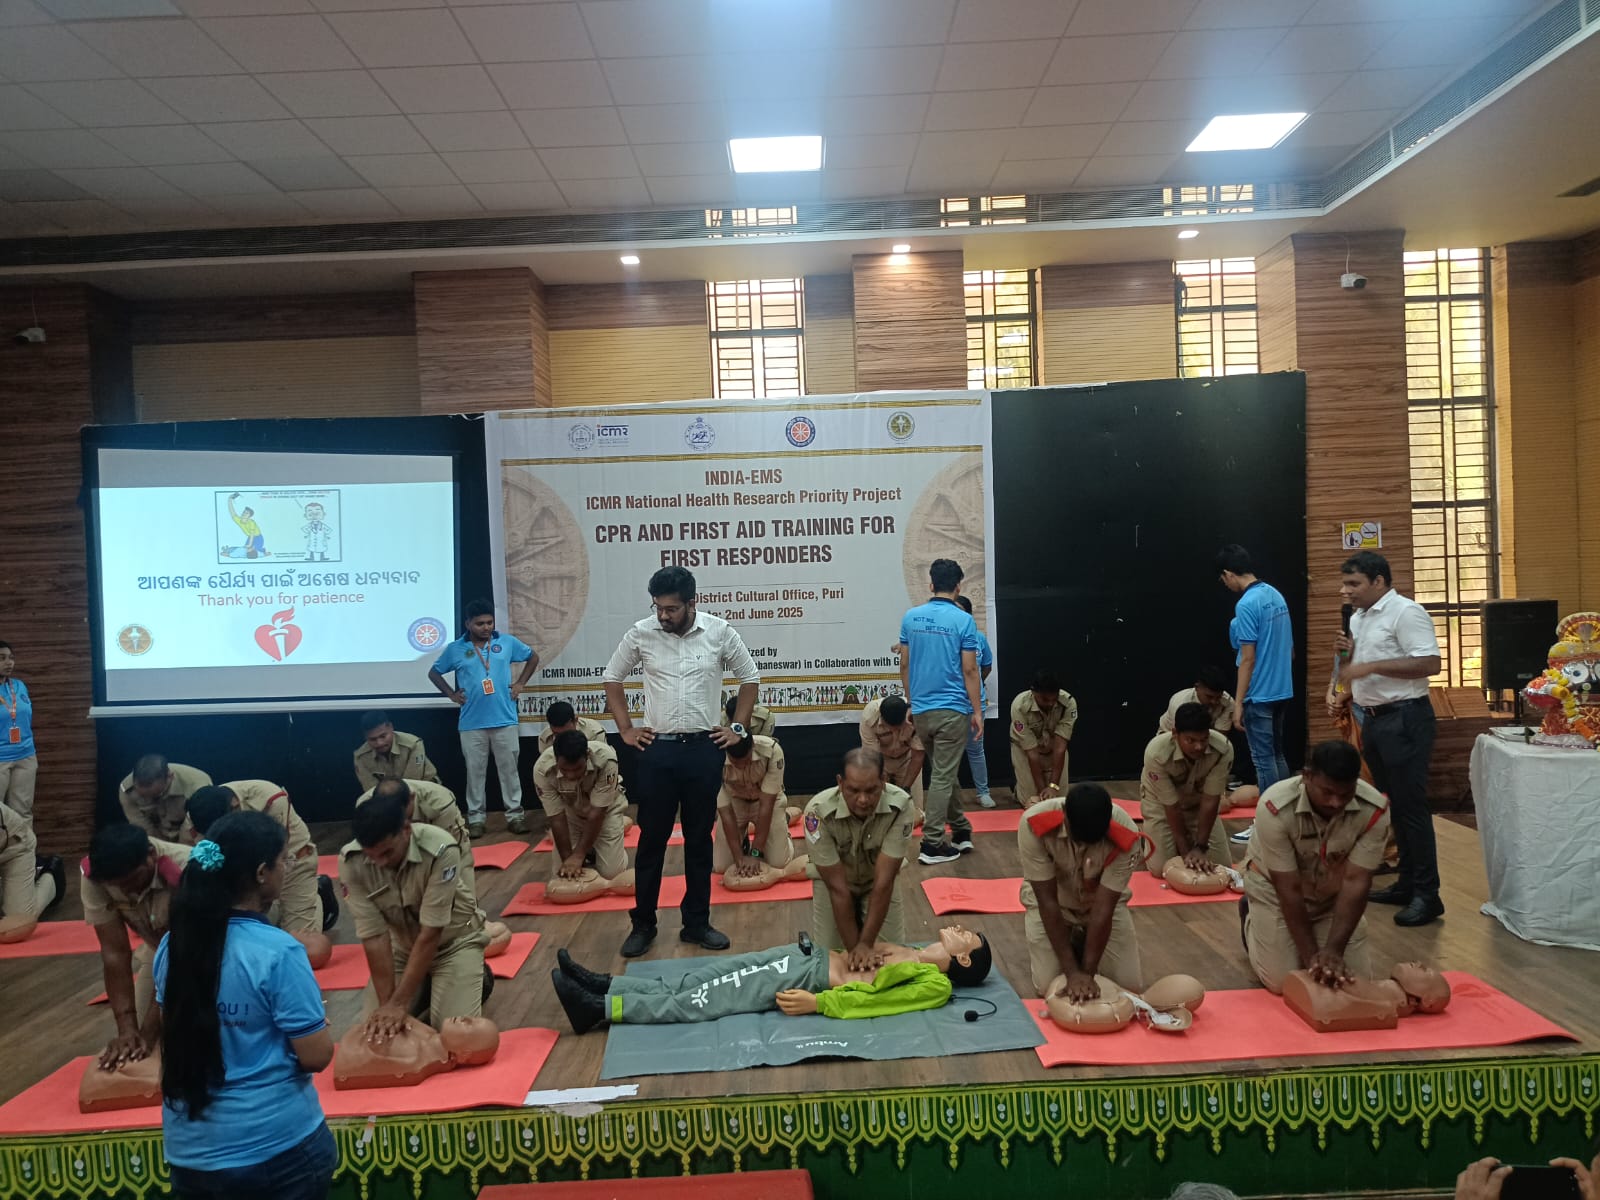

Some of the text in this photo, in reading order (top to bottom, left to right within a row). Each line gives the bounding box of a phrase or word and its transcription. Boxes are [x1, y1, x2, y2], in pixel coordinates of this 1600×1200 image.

[705, 468, 783, 486] INDIA-EMS
[586, 486, 902, 510] ICMR National Health Research Priority Project
[595, 515, 896, 544] CPR AND FIRST AID TRAINING FOR
[660, 544, 833, 568] FIRST RESPONDERS
[197, 591, 365, 608] Thank you for patience
[735, 589, 779, 603] Cultural
[782, 589, 819, 602] Office,
[822, 587, 844, 600] Puri
[725, 609, 745, 620] 2nd
[748, 608, 774, 620] June
[777, 607, 803, 618] 2025
[767, 647, 778, 657] by
[756, 660, 801, 670] baneswar)
[804, 660, 812, 669] in
[815, 658, 871, 669] Collaboration
[873, 657, 891, 667] with
[542, 668, 565, 679] ICMR
[217, 1001, 238, 1016] OU
